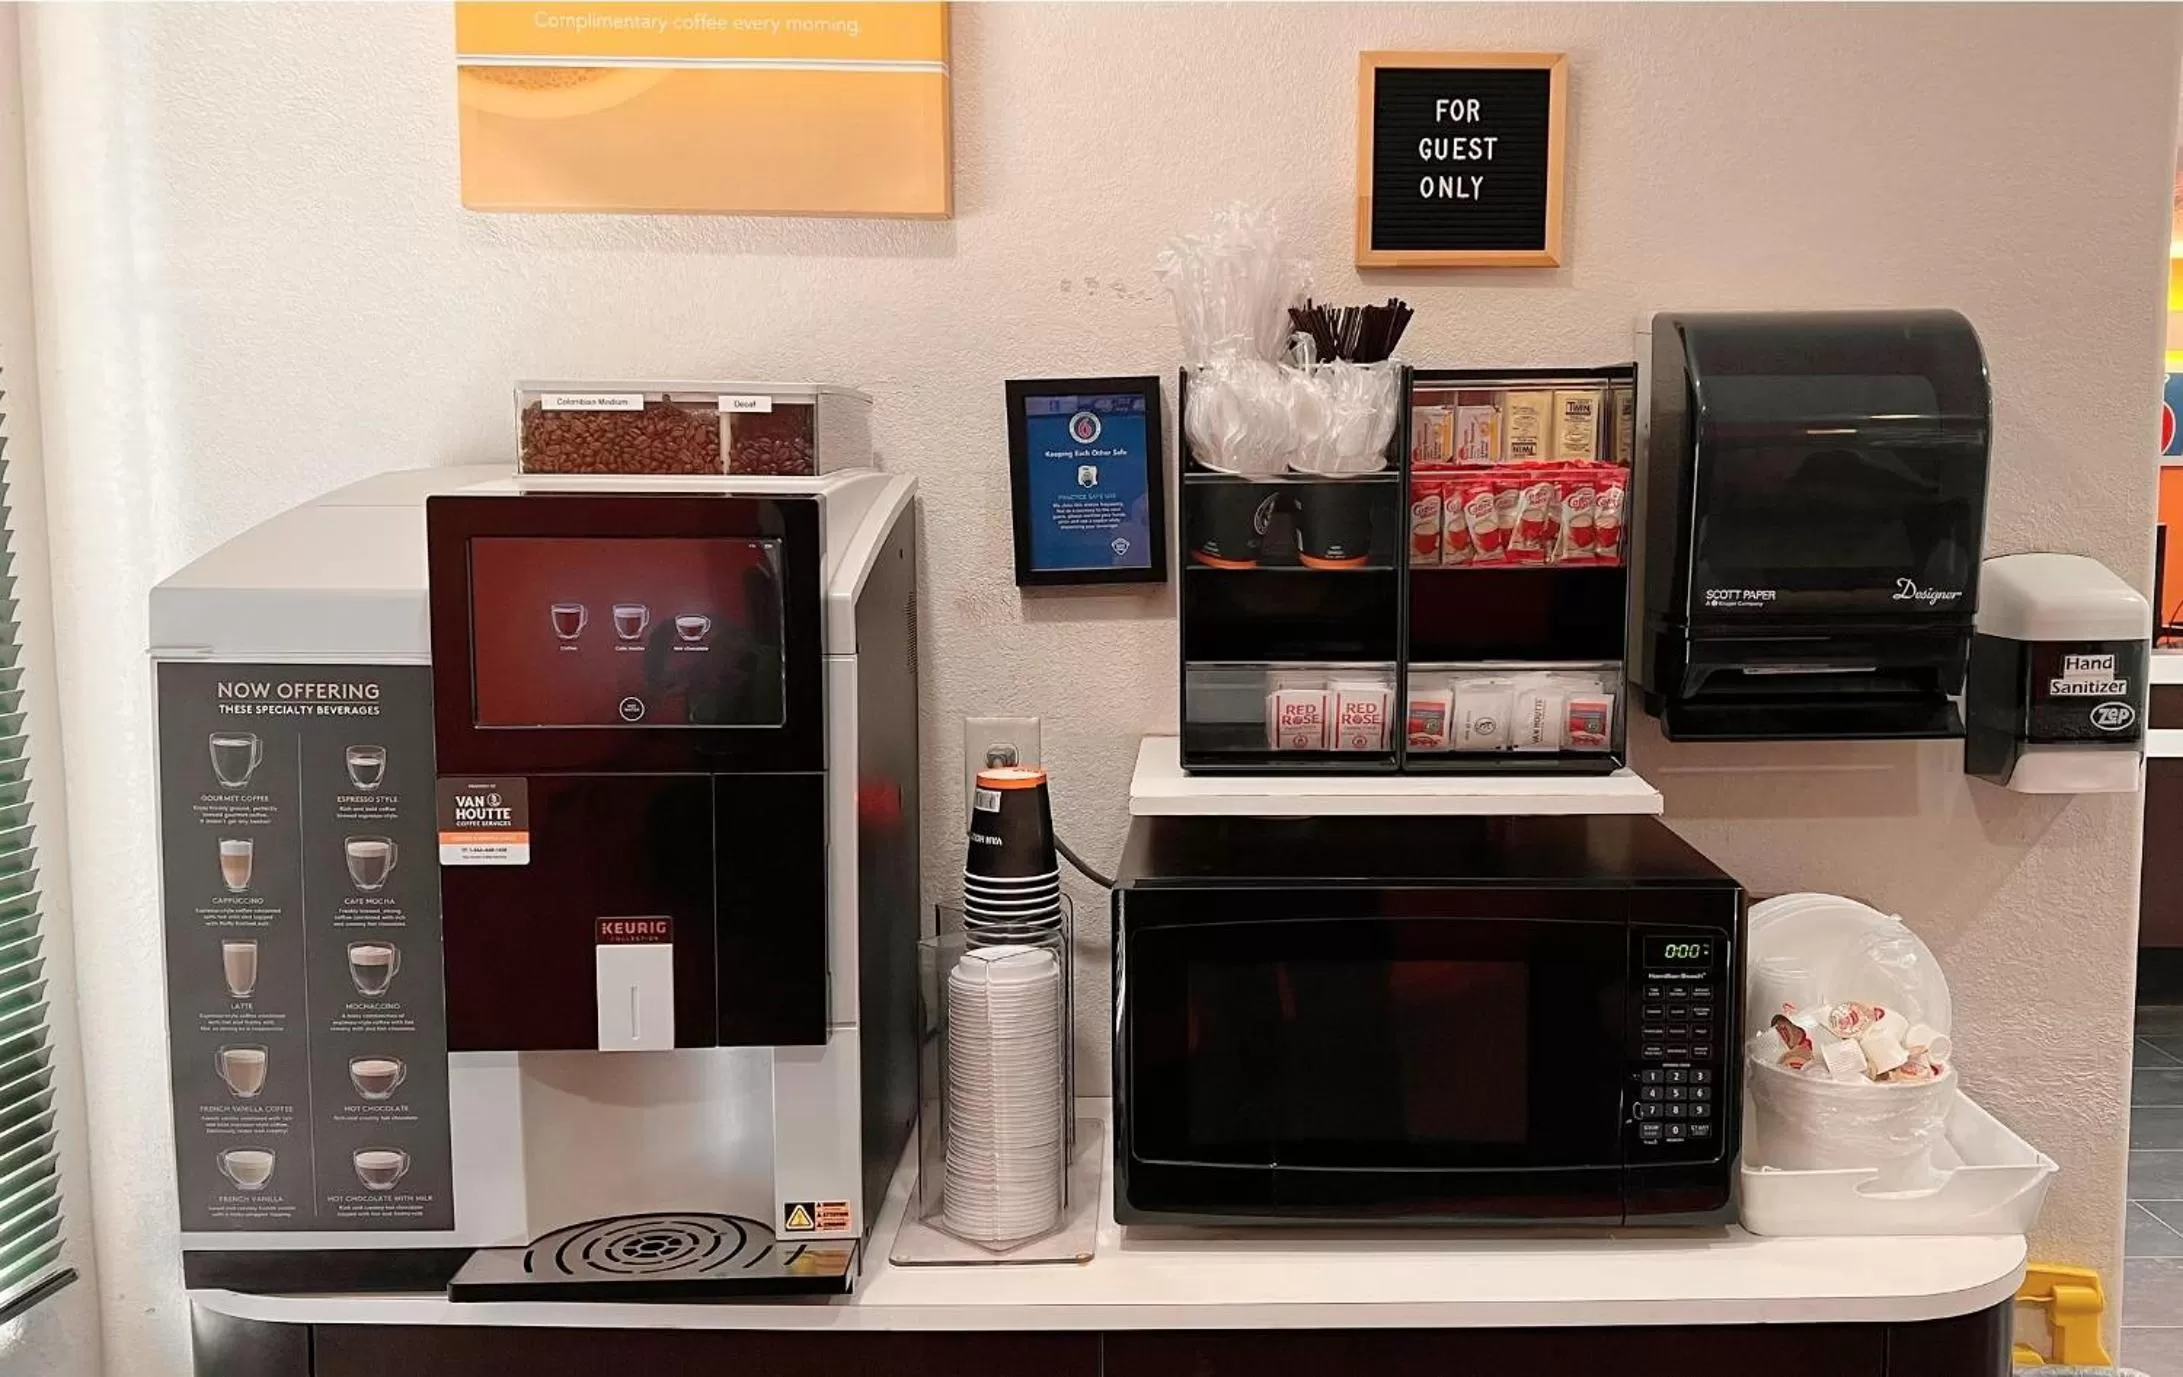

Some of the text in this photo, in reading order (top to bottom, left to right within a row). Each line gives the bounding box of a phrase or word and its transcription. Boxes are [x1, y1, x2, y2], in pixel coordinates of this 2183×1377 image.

[535, 11, 667, 33] Complimentary
[673, 13, 728, 31] coffee
[735, 18, 780, 35] every
[1436, 99, 1480, 122] FOR
[1419, 137, 1498, 161] GUEST
[1420, 176, 1484, 200] ONLY
[734, 400, 756, 408] Decaf
[1112, 448, 1127, 456] Safe
[1706, 589, 1776, 600] SCOTT PAPER
[1892, 577, 1962, 605] Designer
[2066, 657, 2113, 670] Hand
[217, 682, 380, 699] NOW OFFERING
[2052, 681, 2125, 694] Sanitizer
[219, 704, 380, 716] THESE SPECIALTY BEVERAGES
[1286, 704, 1316, 715] RED
[1346, 703, 1377, 714] RED
[1282, 714, 1322, 725] ROSE
[1342, 714, 1381, 724] ROSE
[455, 796, 485, 807] VAN
[455, 808, 512, 820] HOUTTE
[602, 921, 667, 935] KEURIG
[1665, 944, 1700, 958] 0:00
[231, 1002, 253, 1010] LATTE
